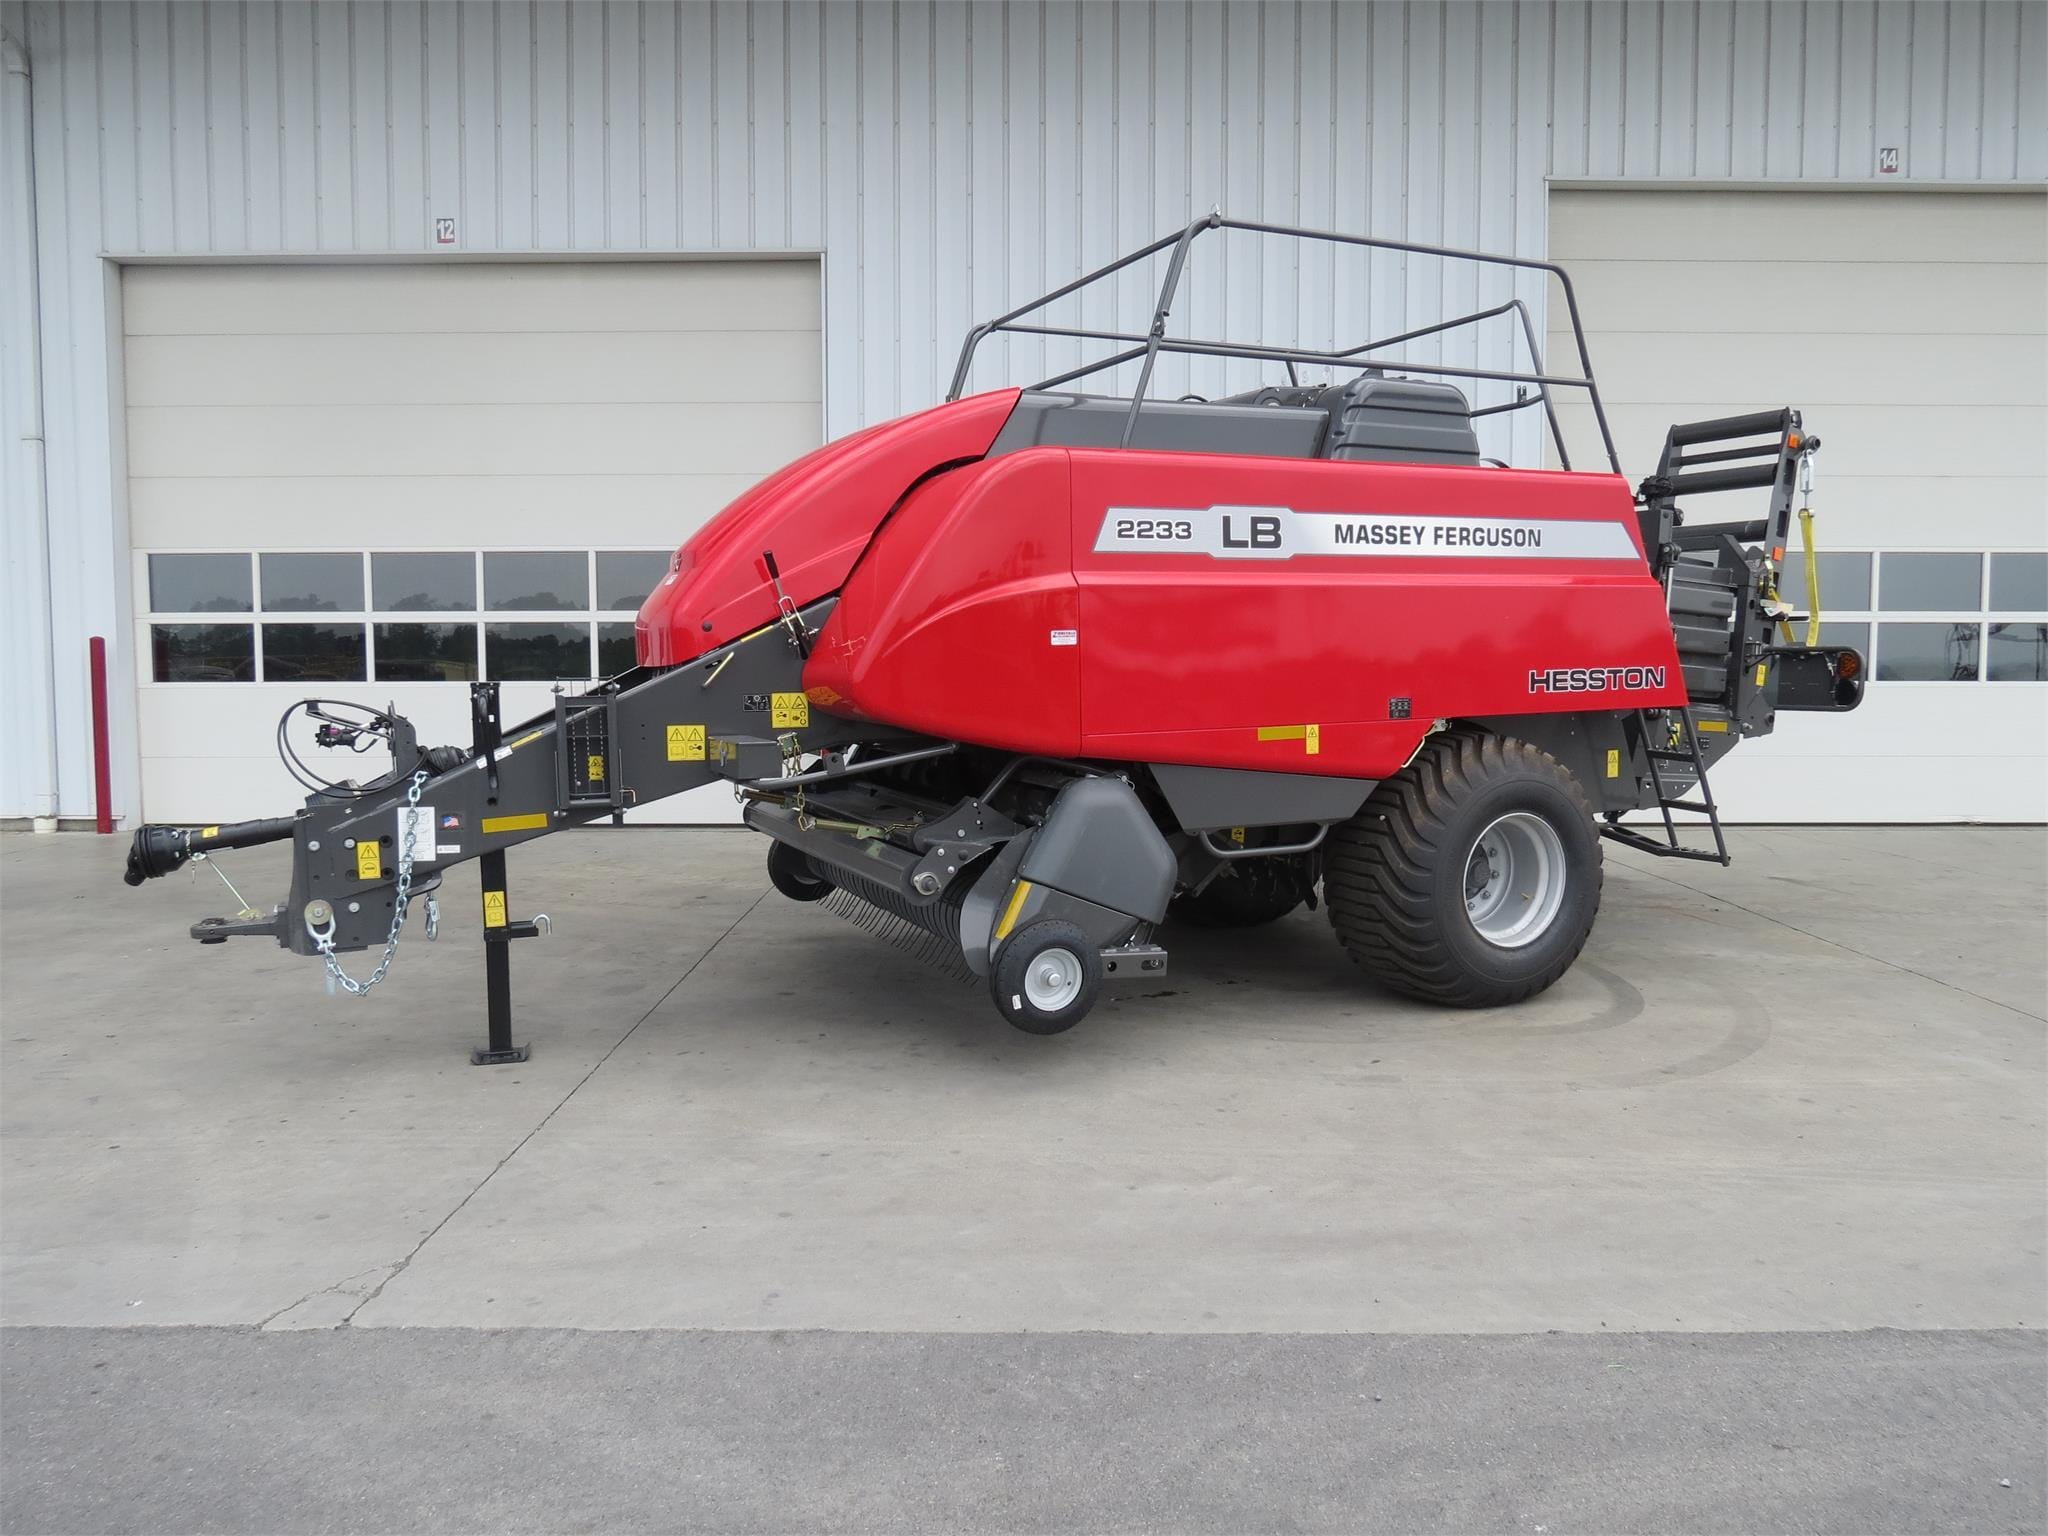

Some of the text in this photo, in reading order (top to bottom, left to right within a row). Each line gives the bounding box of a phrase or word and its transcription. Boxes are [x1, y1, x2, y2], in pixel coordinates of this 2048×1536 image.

[1880, 150, 1897, 168] 14
[437, 220, 454, 239] 12
[1116, 520, 1193, 540] 2233
[1221, 515, 1282, 549] LB
[1334, 523, 1542, 548] MASSEY FERGUSON
[1528, 666, 1666, 693] HESSTON
